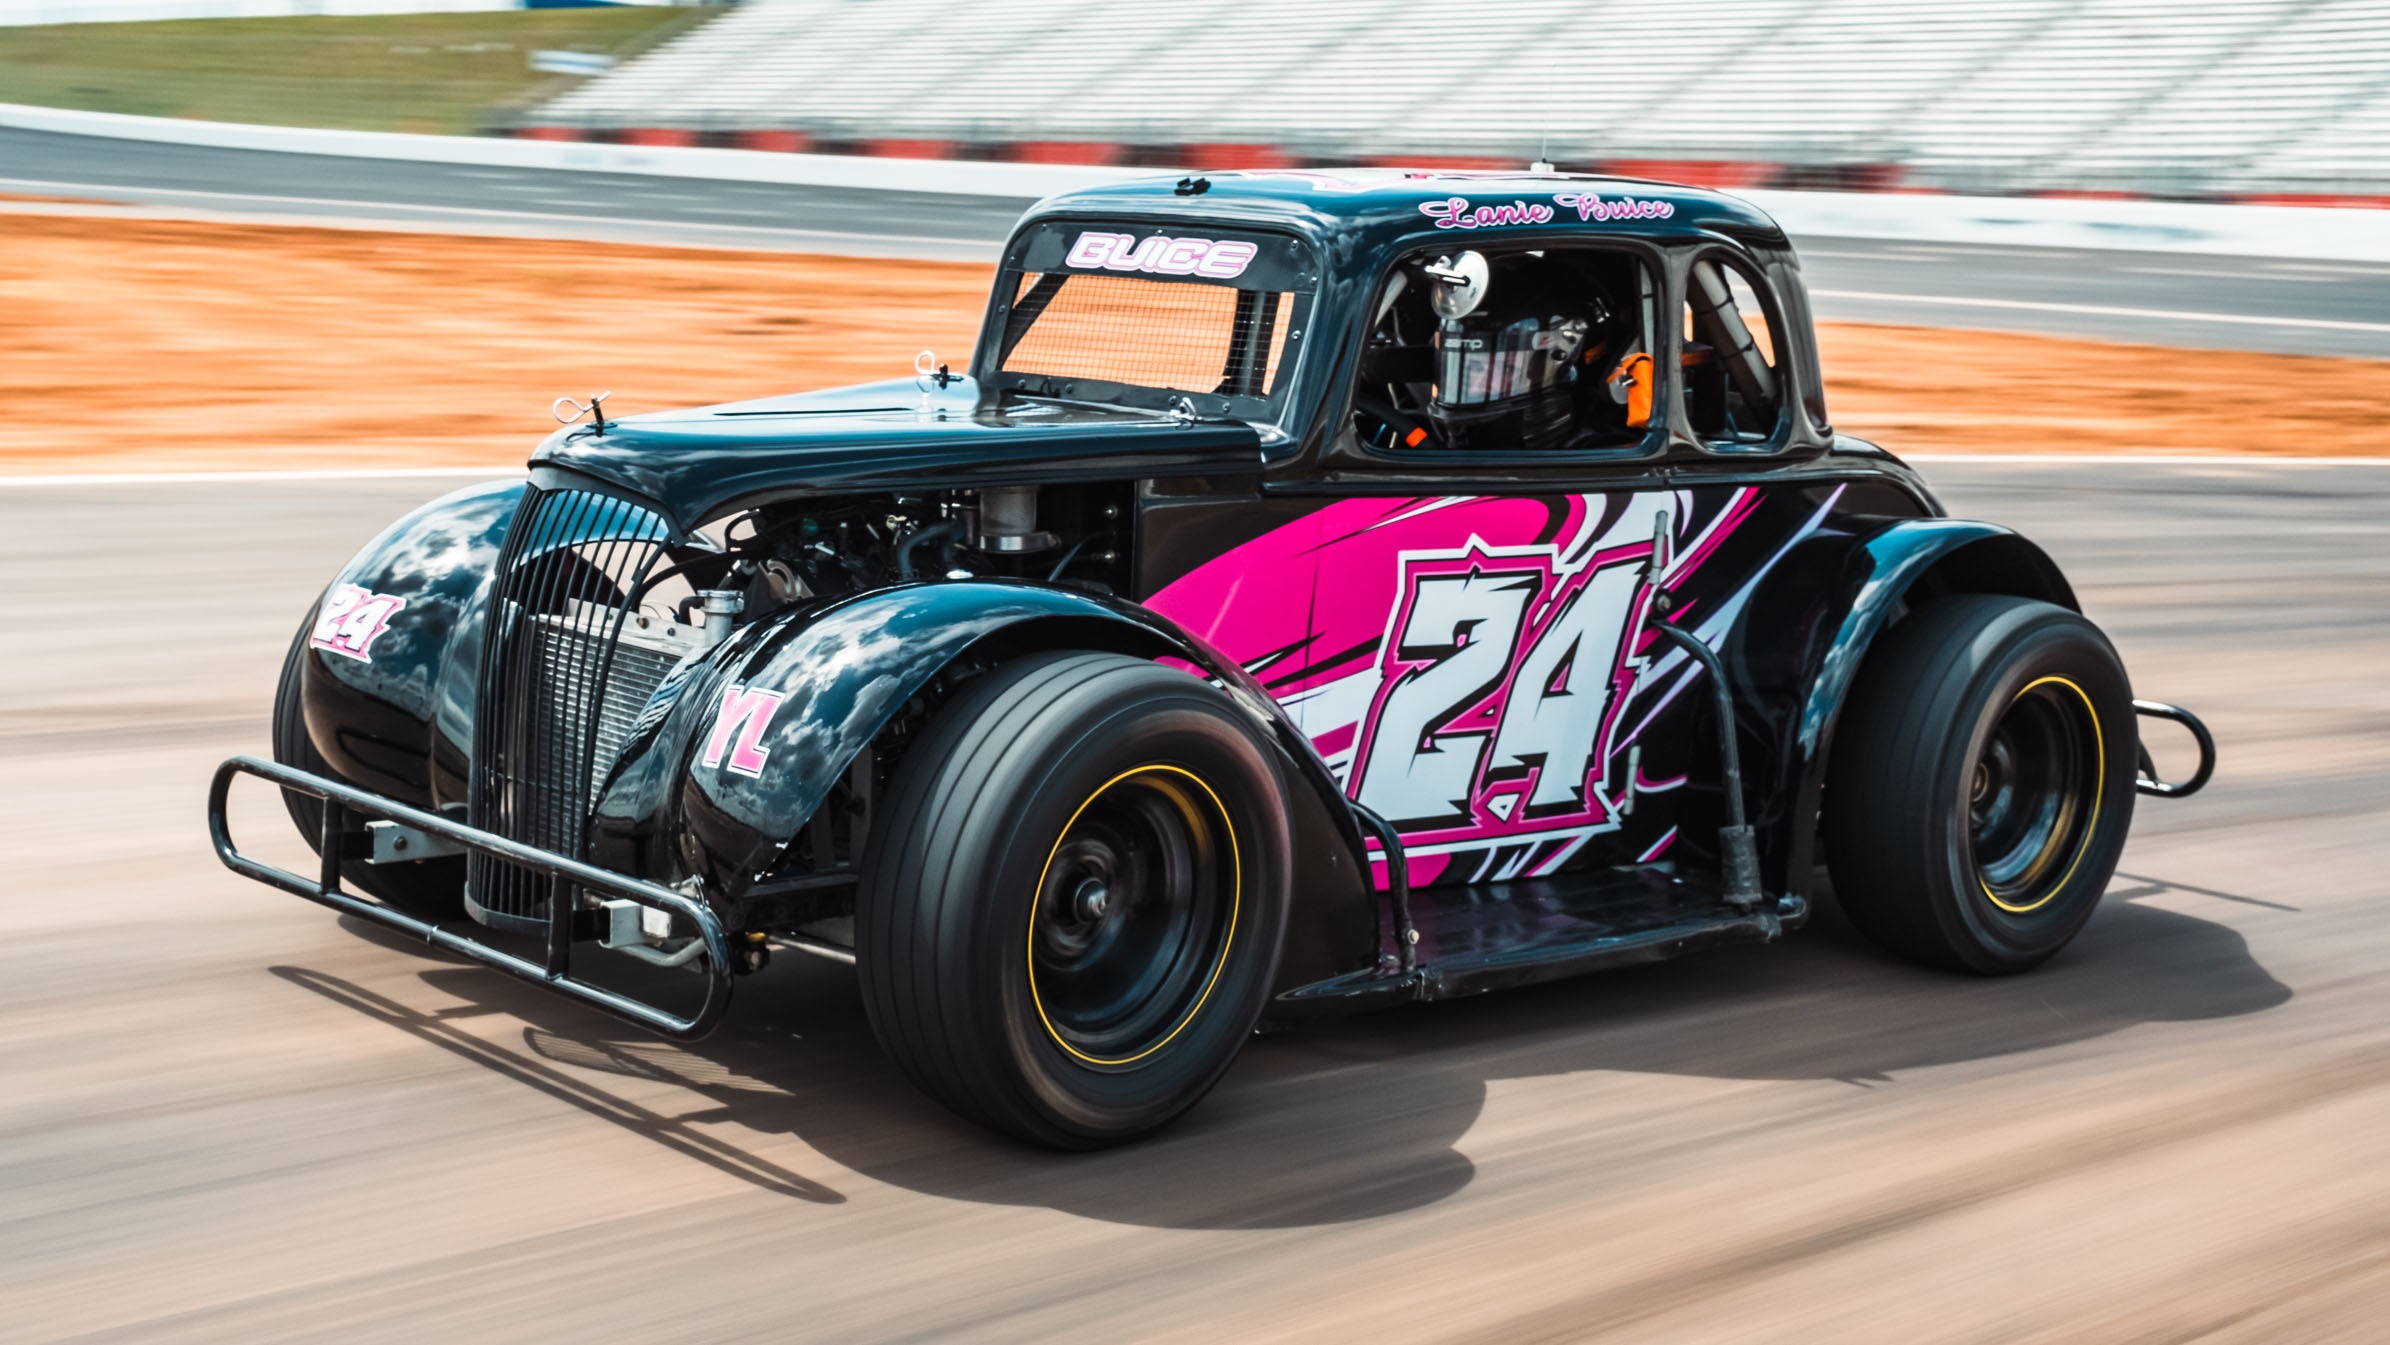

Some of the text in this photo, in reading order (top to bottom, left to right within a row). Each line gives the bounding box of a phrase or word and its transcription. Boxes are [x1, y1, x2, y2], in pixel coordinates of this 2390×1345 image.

[1418, 192, 1674, 229] Lanie Buice
[1065, 231, 1258, 279] BUICE
[310, 584, 403, 659] 24
[1356, 555, 1656, 828] 24
[702, 684, 786, 779] YL
